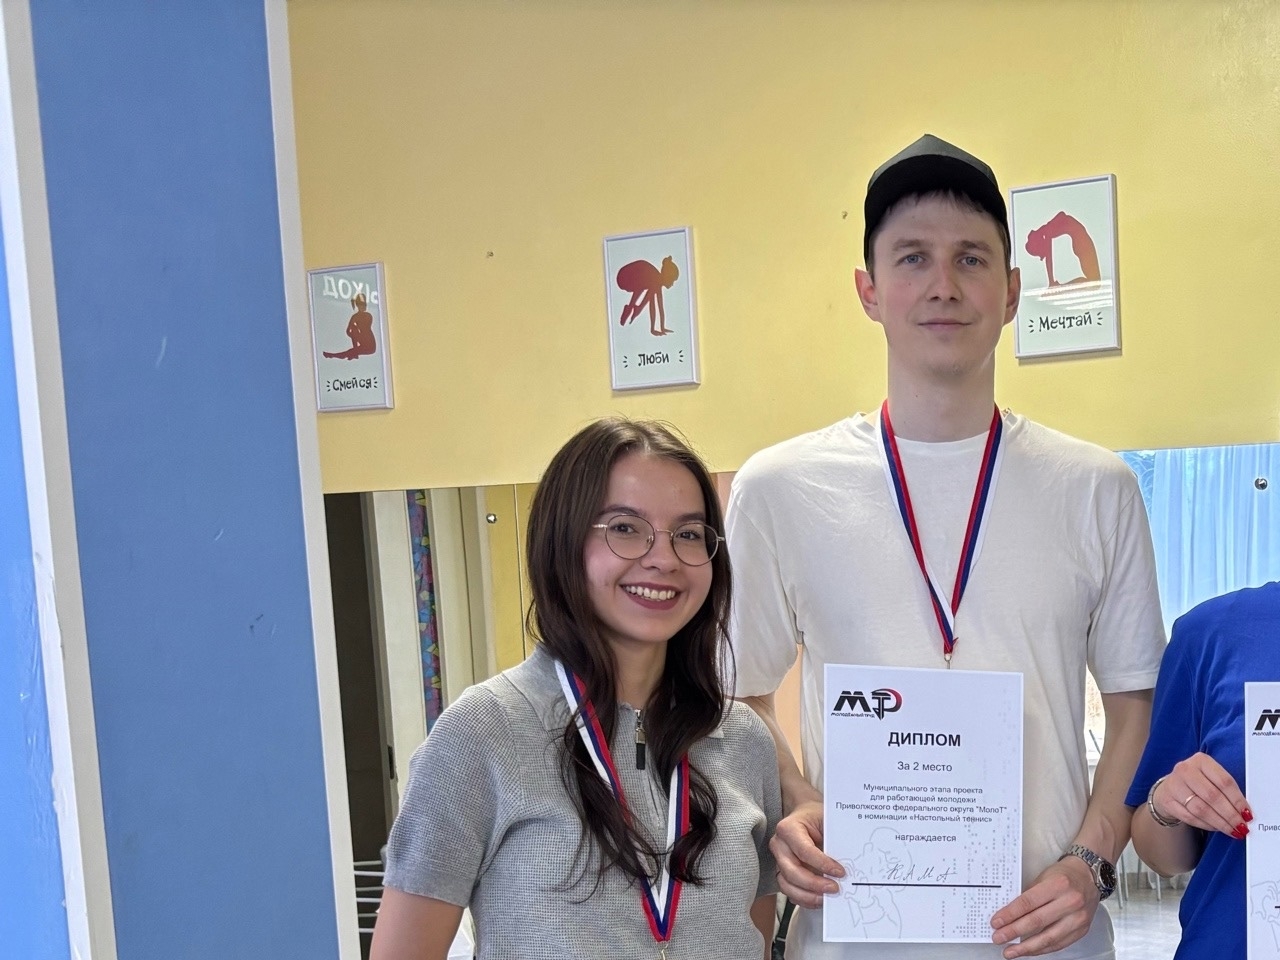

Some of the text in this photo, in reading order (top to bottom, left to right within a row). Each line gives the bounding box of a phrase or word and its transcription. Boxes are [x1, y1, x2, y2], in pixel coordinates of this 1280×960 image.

[1039, 311, 1092, 332] Мечтай
[638, 351, 669, 366] Люби
[332, 377, 372, 391] Смейся
[888, 732, 961, 747] ДИПЛОМ
[898, 761, 952, 772] За 2 место
[863, 784, 983, 795] Муниципального этапа проекта
[870, 793, 976, 804] для работающей молодежи
[836, 802, 890, 811] Приволжского
[893, 804, 948, 814] федерального
[950, 806, 974, 814] округа
[864, 814, 907, 822] номинации
[895, 833, 956, 842] награждается
